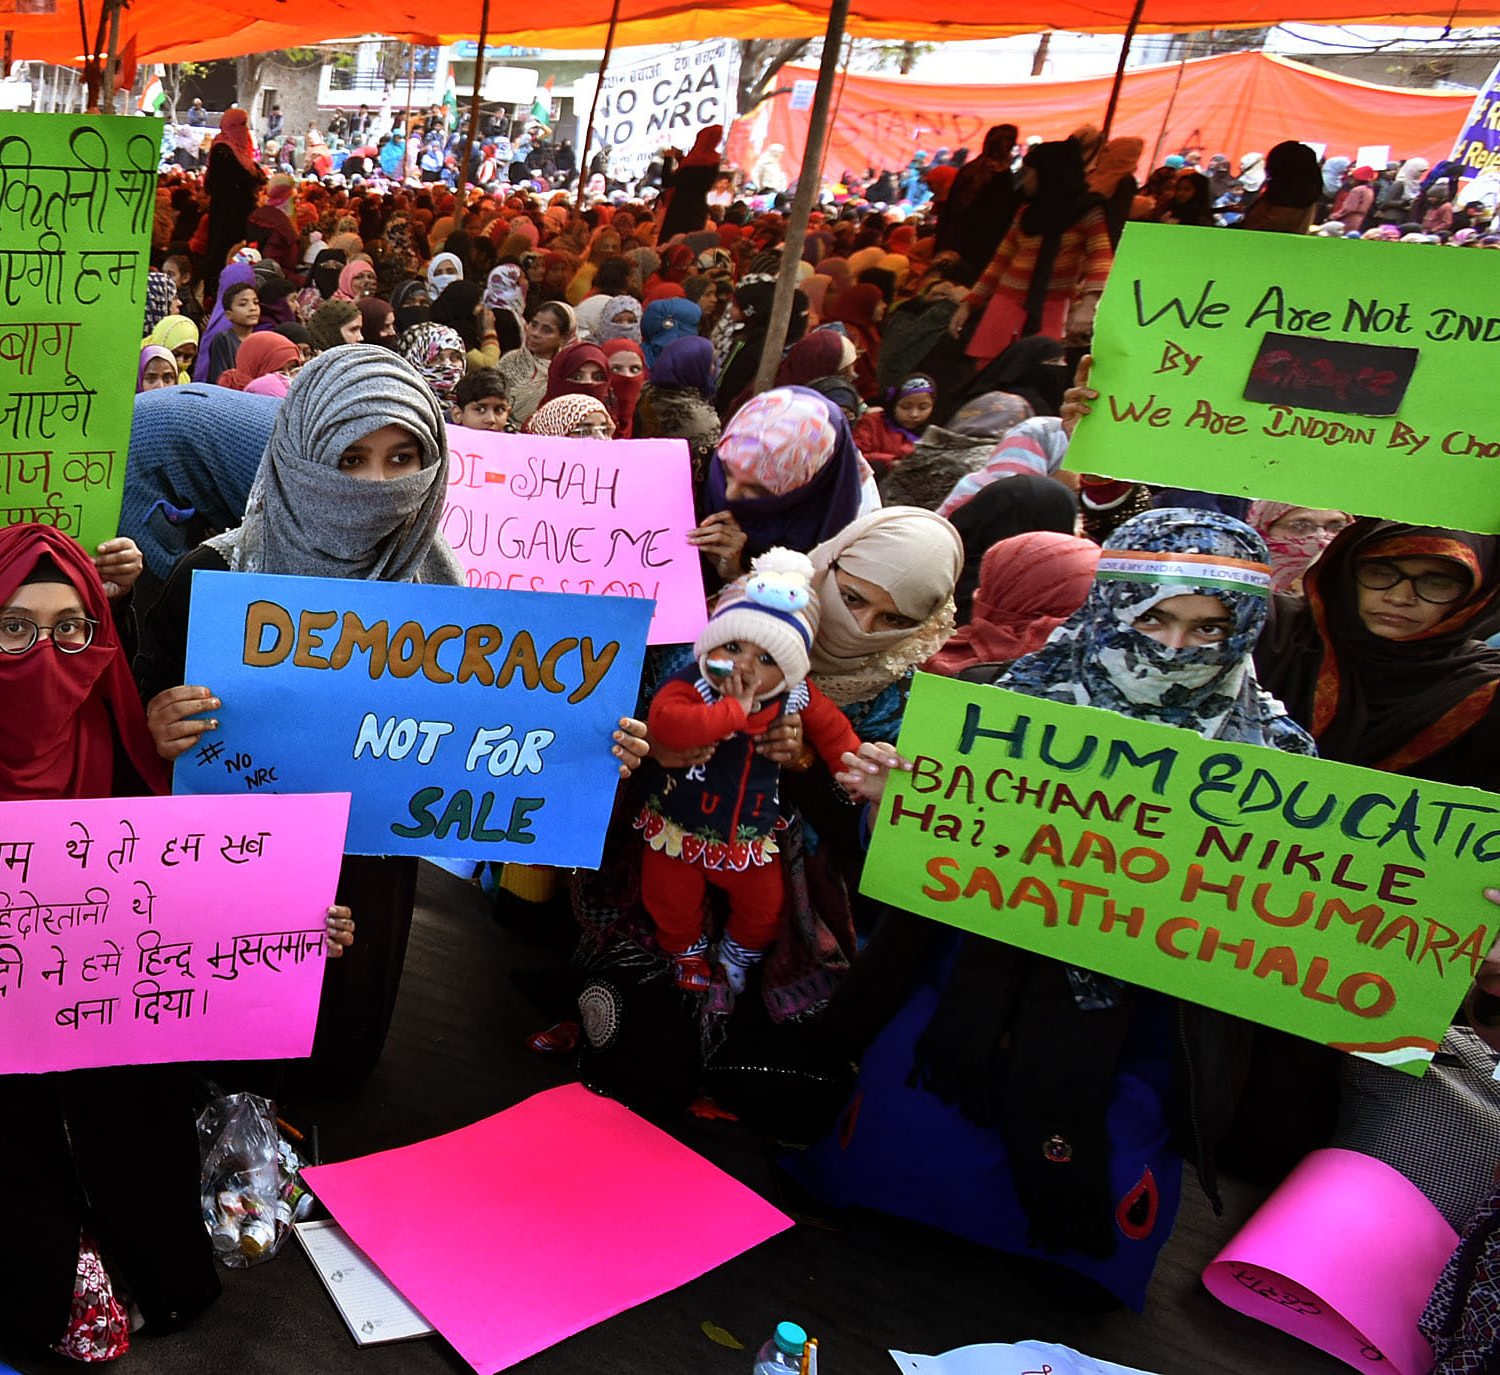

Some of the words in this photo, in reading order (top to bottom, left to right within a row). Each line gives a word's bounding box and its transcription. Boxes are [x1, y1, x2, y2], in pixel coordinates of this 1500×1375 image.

[653, 63, 720, 106] CAA
[646, 97, 718, 135] NRC
[115, 134, 158, 234] भी
[74, 250, 140, 304] हम
[1133, 279, 1230, 329] We
[1245, 286, 1331, 331] Are
[1342, 298, 1413, 334] Not
[1153, 340, 1203, 375] By
[1109, 394, 1171, 427] We
[1184, 399, 1249, 435] Are
[1262, 404, 1376, 446] INDIAN
[1386, 420, 1430, 456] By
[63, 451, 116, 492] का
[440, 502, 488, 556] OU
[498, 516, 596, 563] GAVE
[604, 527, 674, 568] ME
[242, 600, 620, 704] DEMOCRACY
[353, 712, 454, 765] NOT
[465, 724, 555, 777] FOR
[957, 702, 1178, 796] HUM
[244, 766, 278, 790] NRC
[390, 786, 545, 844] SALE
[911, 755, 1172, 839] BACHANE
[1196, 826, 1426, 905] NIKLE
[67, 821, 94, 868] थे
[107, 820, 140, 873] तो
[161, 834, 204, 866] हम
[220, 832, 271, 863] सब
[132, 881, 157, 924] थे
[1019, 823, 1170, 883] AAO
[1180, 864, 1487, 978] HUMARA
[41, 946, 68, 985] ने
[207, 930, 326, 980] मुसलमान
[922, 857, 1145, 938] SAATH
[1155, 917, 1397, 1018] CHALO
[55, 998, 119, 1030] बना
